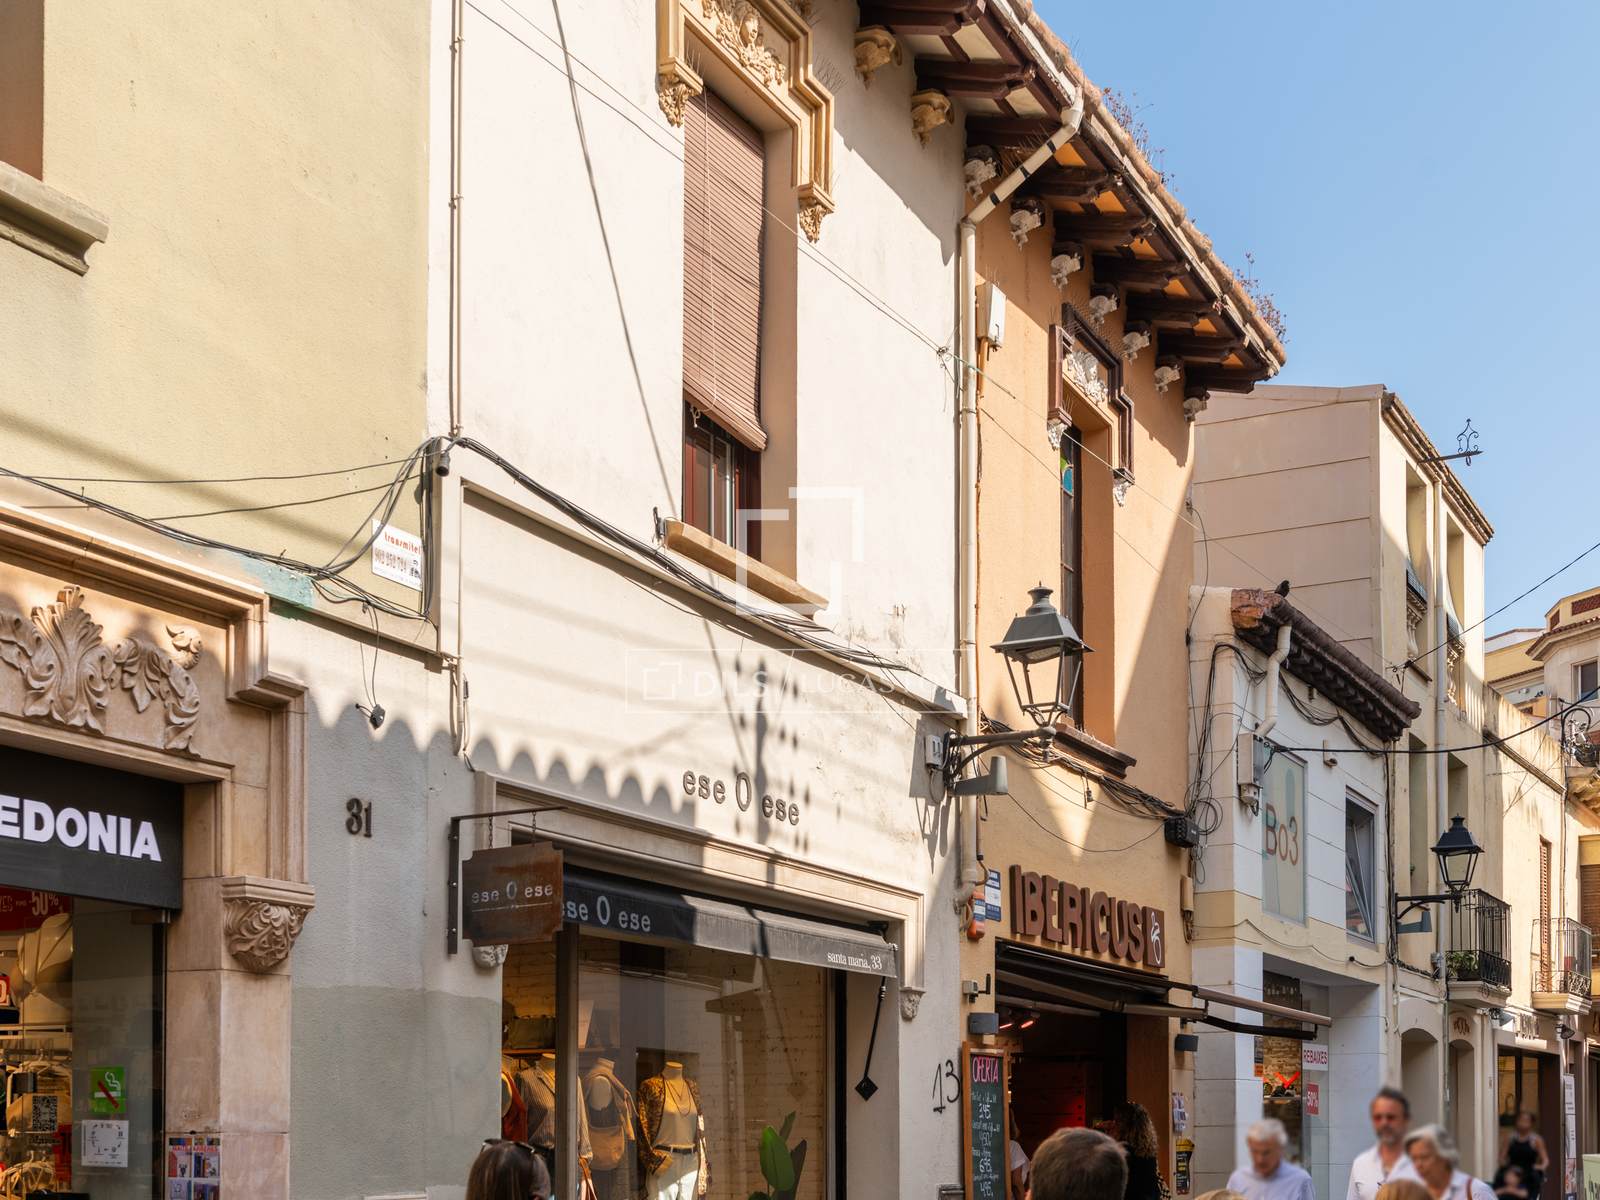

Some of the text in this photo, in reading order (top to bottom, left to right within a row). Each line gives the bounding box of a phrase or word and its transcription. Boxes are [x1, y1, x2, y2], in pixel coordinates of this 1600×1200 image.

[683, 770, 726, 804] ese
[762, 795, 800, 826] ese
[0, 794, 162, 862] EDONIA
[471, 889, 499, 904] ese
[524, 882, 553, 898] ese
[1009, 864, 1145, 963] IBERICUS
[618, 910, 651, 932] ese
[827, 952, 847, 965] santa
[871, 954, 882, 970] 33
[932, 1059, 961, 1114] 13
[972, 1056, 999, 1083] OFERTA
